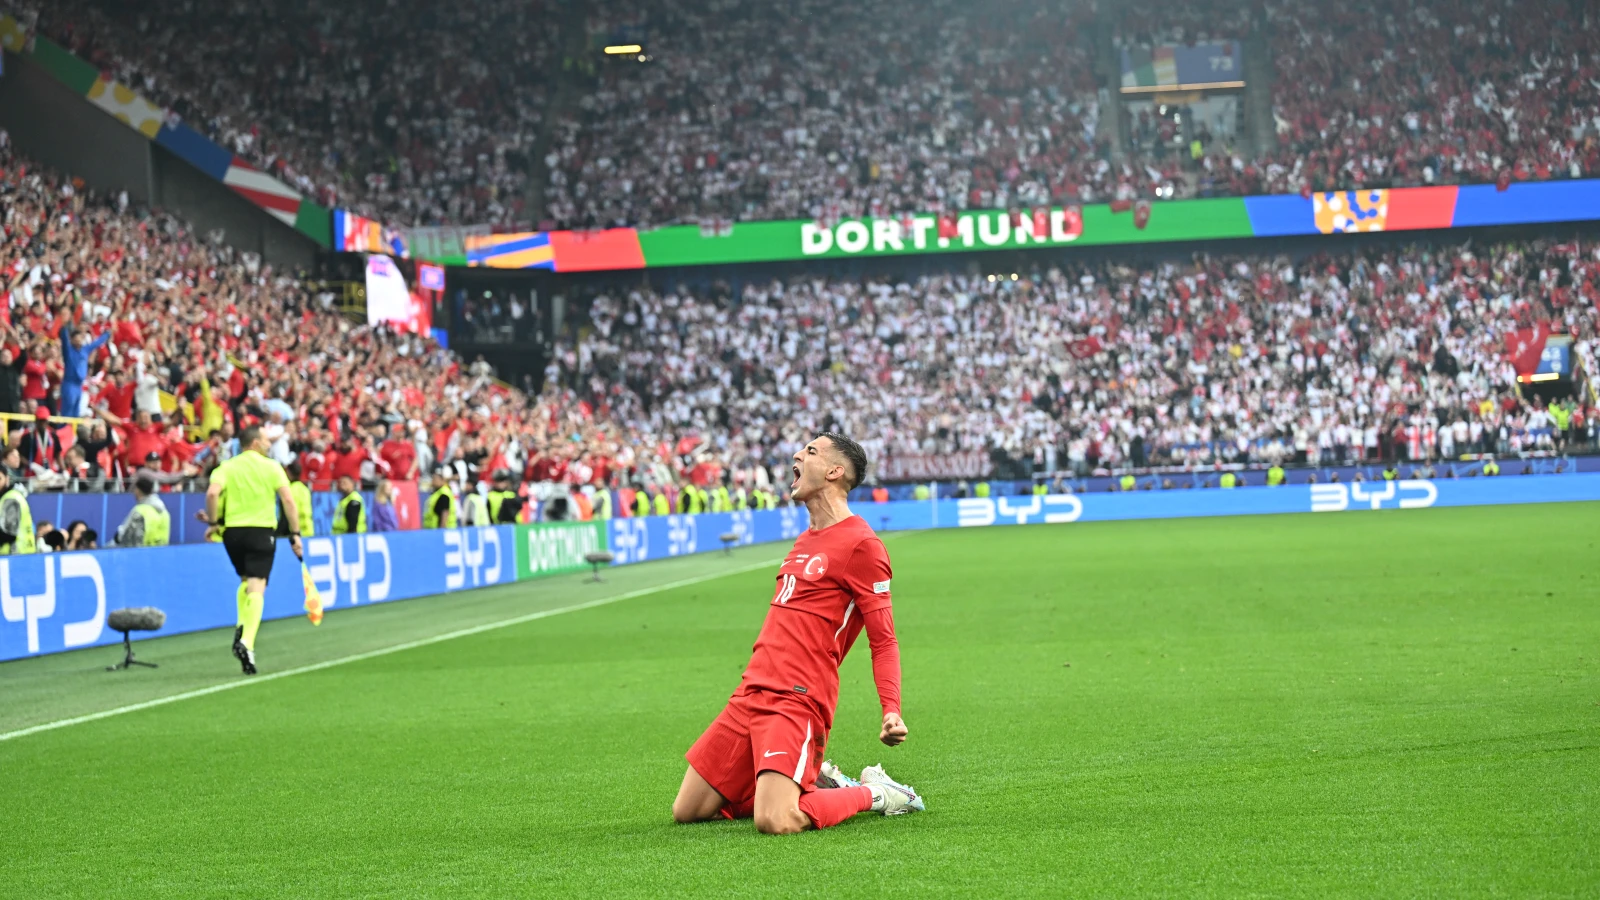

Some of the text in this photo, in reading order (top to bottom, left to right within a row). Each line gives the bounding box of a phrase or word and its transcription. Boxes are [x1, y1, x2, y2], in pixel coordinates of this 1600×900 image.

[1209, 56, 1232, 71] 73
[801, 211, 1082, 254] DORTMUND
[957, 494, 1083, 527] BYD
[1310, 479, 1438, 512] BYD
[444, 525, 502, 589] BYD
[527, 524, 600, 573] DORTMUND
[614, 517, 649, 563] BYD
[308, 534, 392, 609] BYD
[775, 573, 796, 604] 18
